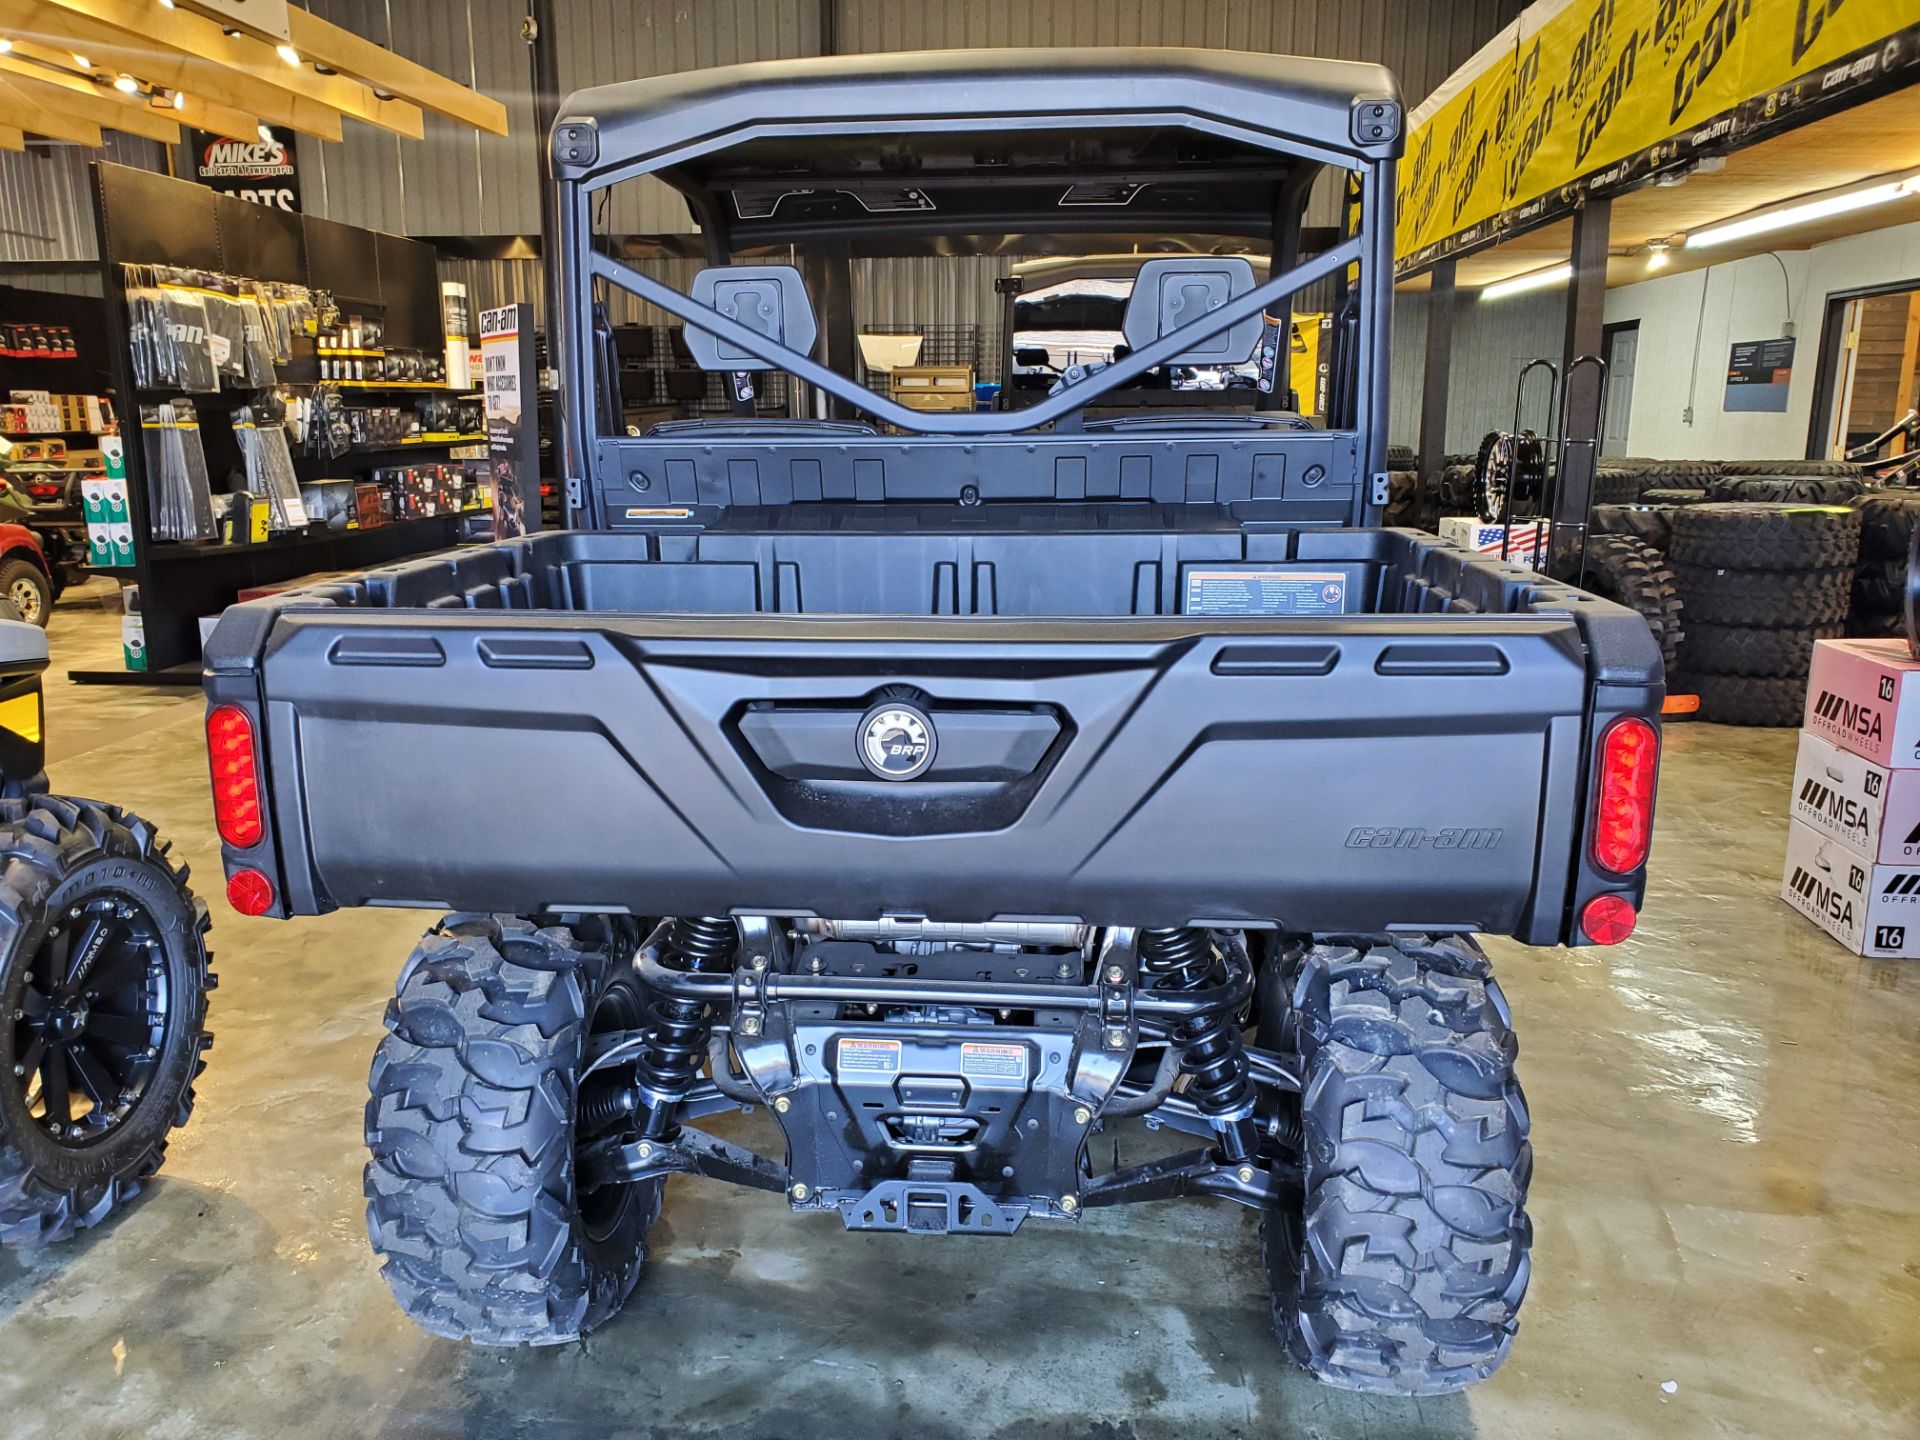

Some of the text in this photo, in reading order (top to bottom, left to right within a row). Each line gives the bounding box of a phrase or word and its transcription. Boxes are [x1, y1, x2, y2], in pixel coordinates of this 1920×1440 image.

[1823, 53, 1877, 89] can-am
[1574, 0, 1690, 170] can-a
[1692, 119, 1731, 147] can-am
[208, 143, 284, 168] MIKE'S
[481, 307, 517, 334] can-am
[1319, 377, 1327, 411] can-am
[1881, 678, 1893, 699] 16
[1842, 700, 1882, 742] MSA
[890, 744, 925, 756] BRP
[1867, 774, 1879, 796] 16
[1829, 790, 1869, 837] MSA
[1345, 827, 1503, 849] can-am
[1851, 868, 1862, 890] 16
[1816, 881, 1853, 930] MSA
[1879, 928, 1902, 947] 16
[981, 1047, 1014, 1055] WARNING
